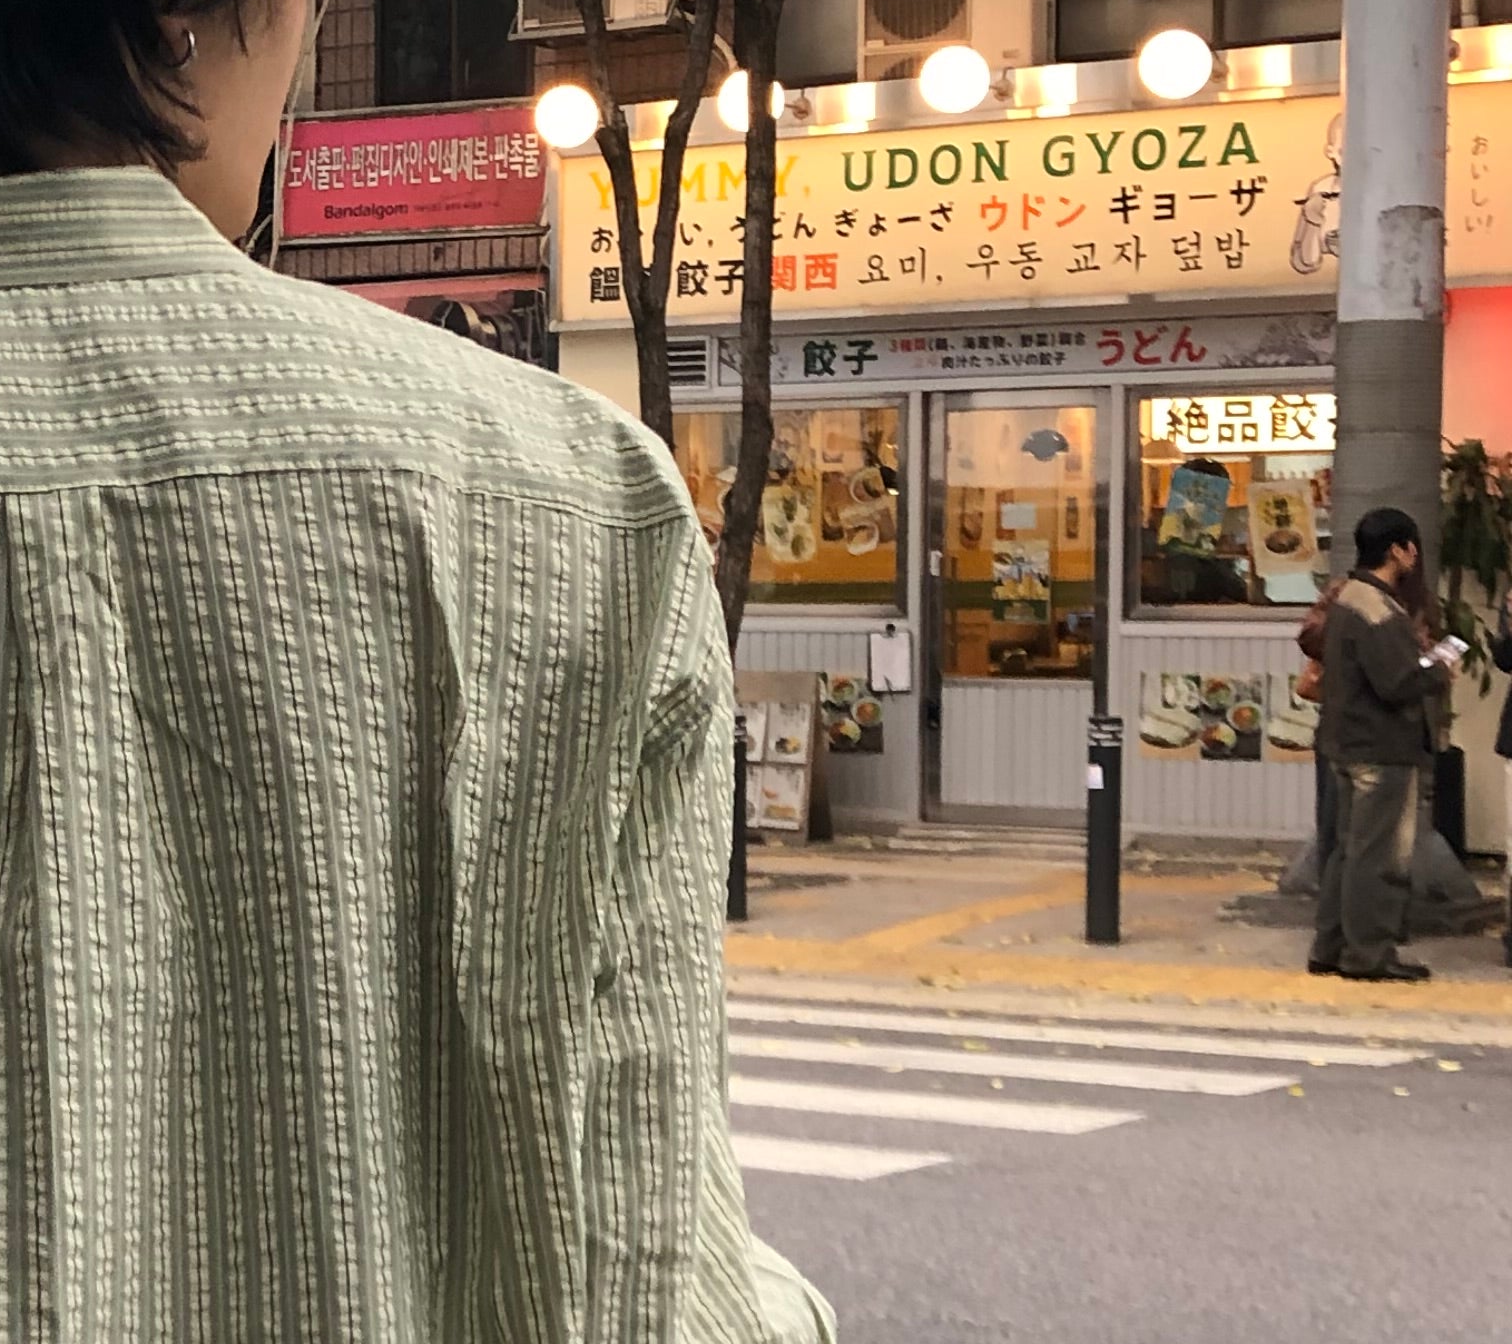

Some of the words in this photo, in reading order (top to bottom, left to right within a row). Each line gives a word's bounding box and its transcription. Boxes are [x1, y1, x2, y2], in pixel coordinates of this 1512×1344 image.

[842, 139, 1009, 192] UDON
[1042, 121, 1260, 178] GYOZA
[979, 192, 1087, 232] ウドン
[1109, 176, 1268, 224] ギョーザ
[966, 241, 1043, 281] 우동
[1066, 234, 1148, 275] 교자
[803, 339, 879, 378] 餃子
[1096, 325, 1208, 367] うどん
[1166, 395, 1337, 444] 絶品餃
